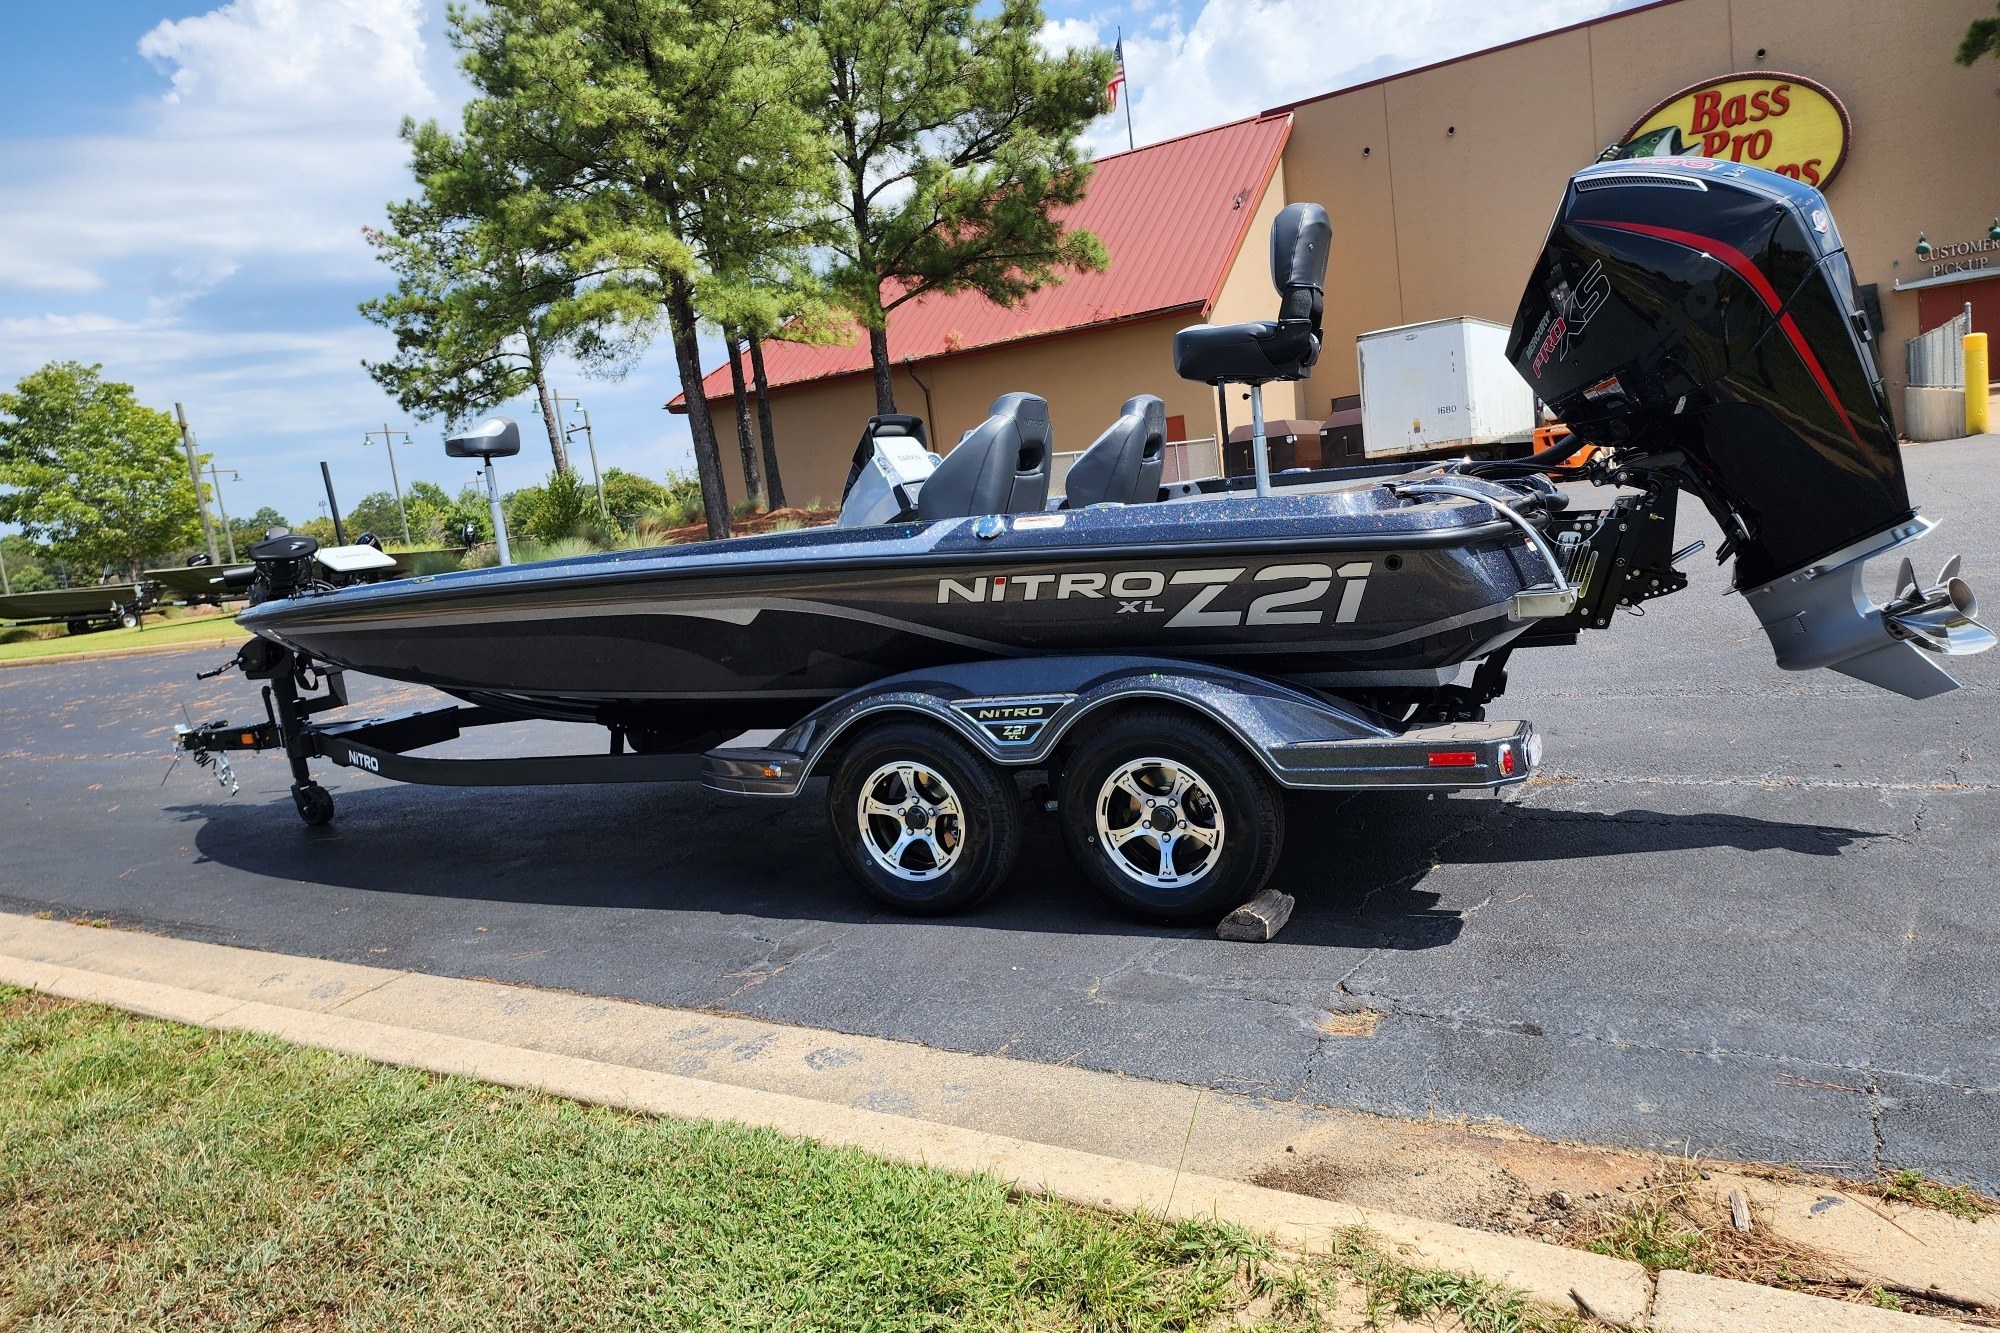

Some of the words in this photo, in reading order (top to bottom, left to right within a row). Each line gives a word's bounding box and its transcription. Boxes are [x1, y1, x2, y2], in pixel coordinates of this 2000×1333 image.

[1688, 84, 1790, 135] Bass
[1703, 128, 1773, 163] Pro
[1932, 262, 1965, 277] PICK
[1968, 257, 1988, 271] UP
[1532, 316, 1567, 379] PRO
[1559, 258, 1611, 363] XS
[1525, 310, 1551, 360] MERCURY
[1437, 405, 1457, 415] 1680
[937, 571, 1164, 604] NITRO
[1163, 561, 1374, 628] Z21
[1115, 600, 1165, 614] XL
[978, 707, 1044, 719] NITRO
[1002, 725, 1027, 736] Z21
[348, 749, 379, 772] NITRO
